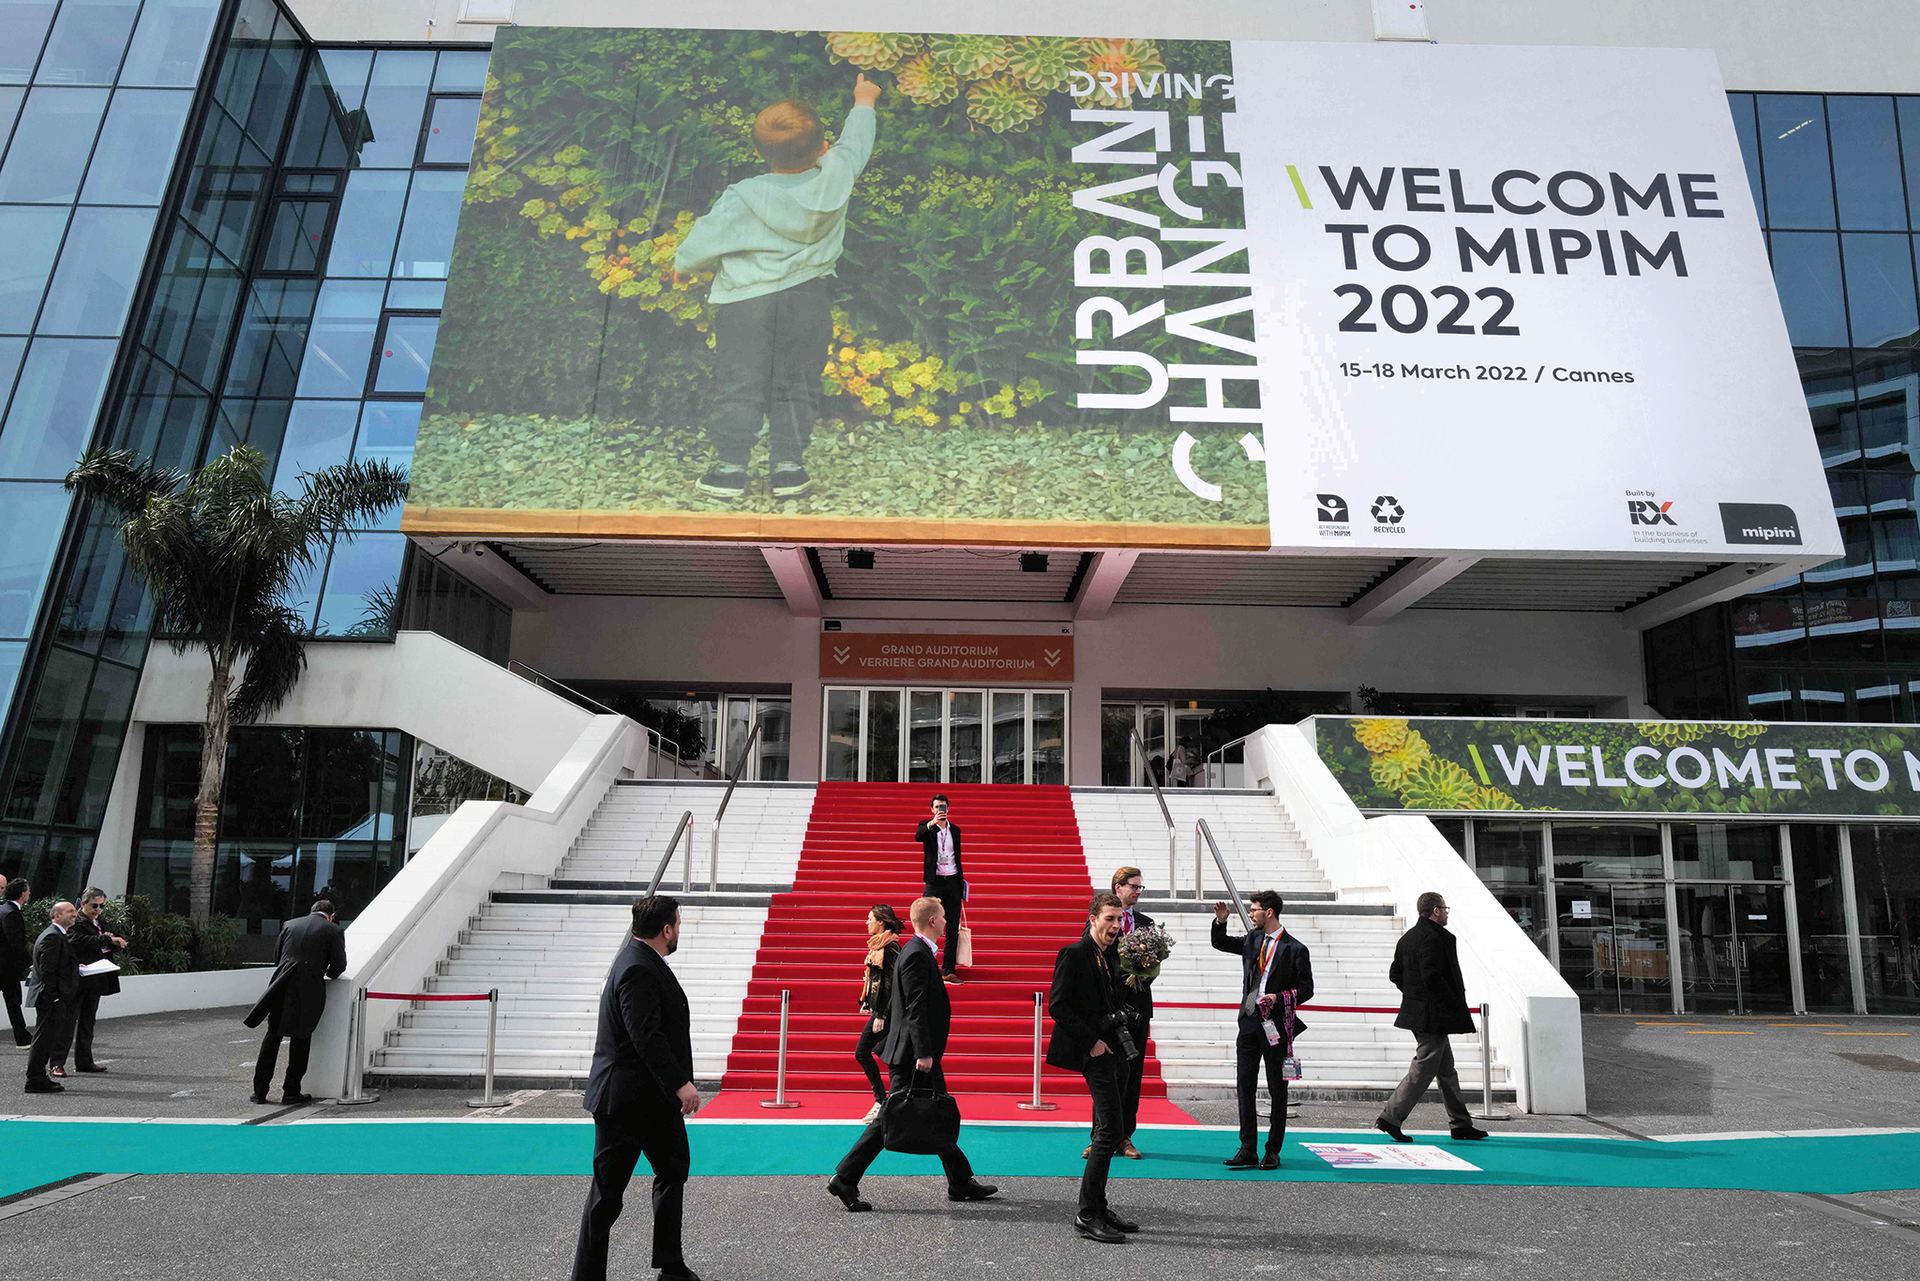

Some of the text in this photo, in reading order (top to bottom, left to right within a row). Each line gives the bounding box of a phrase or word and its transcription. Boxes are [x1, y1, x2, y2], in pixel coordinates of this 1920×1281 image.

[1069, 70, 1235, 100] DRIVING
[1318, 165, 1725, 218] WELCOME
[1071, 109, 1170, 410] URBAN
[1325, 224, 1688, 277] TO MIPIM
[1156, 111, 1266, 502] CHANGE
[1334, 284, 1520, 336] 2022
[1400, 363, 1471, 380] March
[1476, 365, 1528, 381] 2022
[1552, 367, 1635, 383] Cannes
[1646, 490, 1656, 498] by
[1627, 501, 1678, 526] RX
[1373, 526, 1406, 534] RECYCLED
[1634, 536, 1709, 545] building businesses
[1656, 530, 1689, 538] business
[1742, 526, 1796, 541] mipim
[881, 644, 998, 656] GRAND AUDITORIUM
[859, 657, 1035, 669] VERRIERE GRAND AUDITORIUM
[1492, 744, 1802, 790] WELCOME
[1807, 749, 1890, 791] TO
